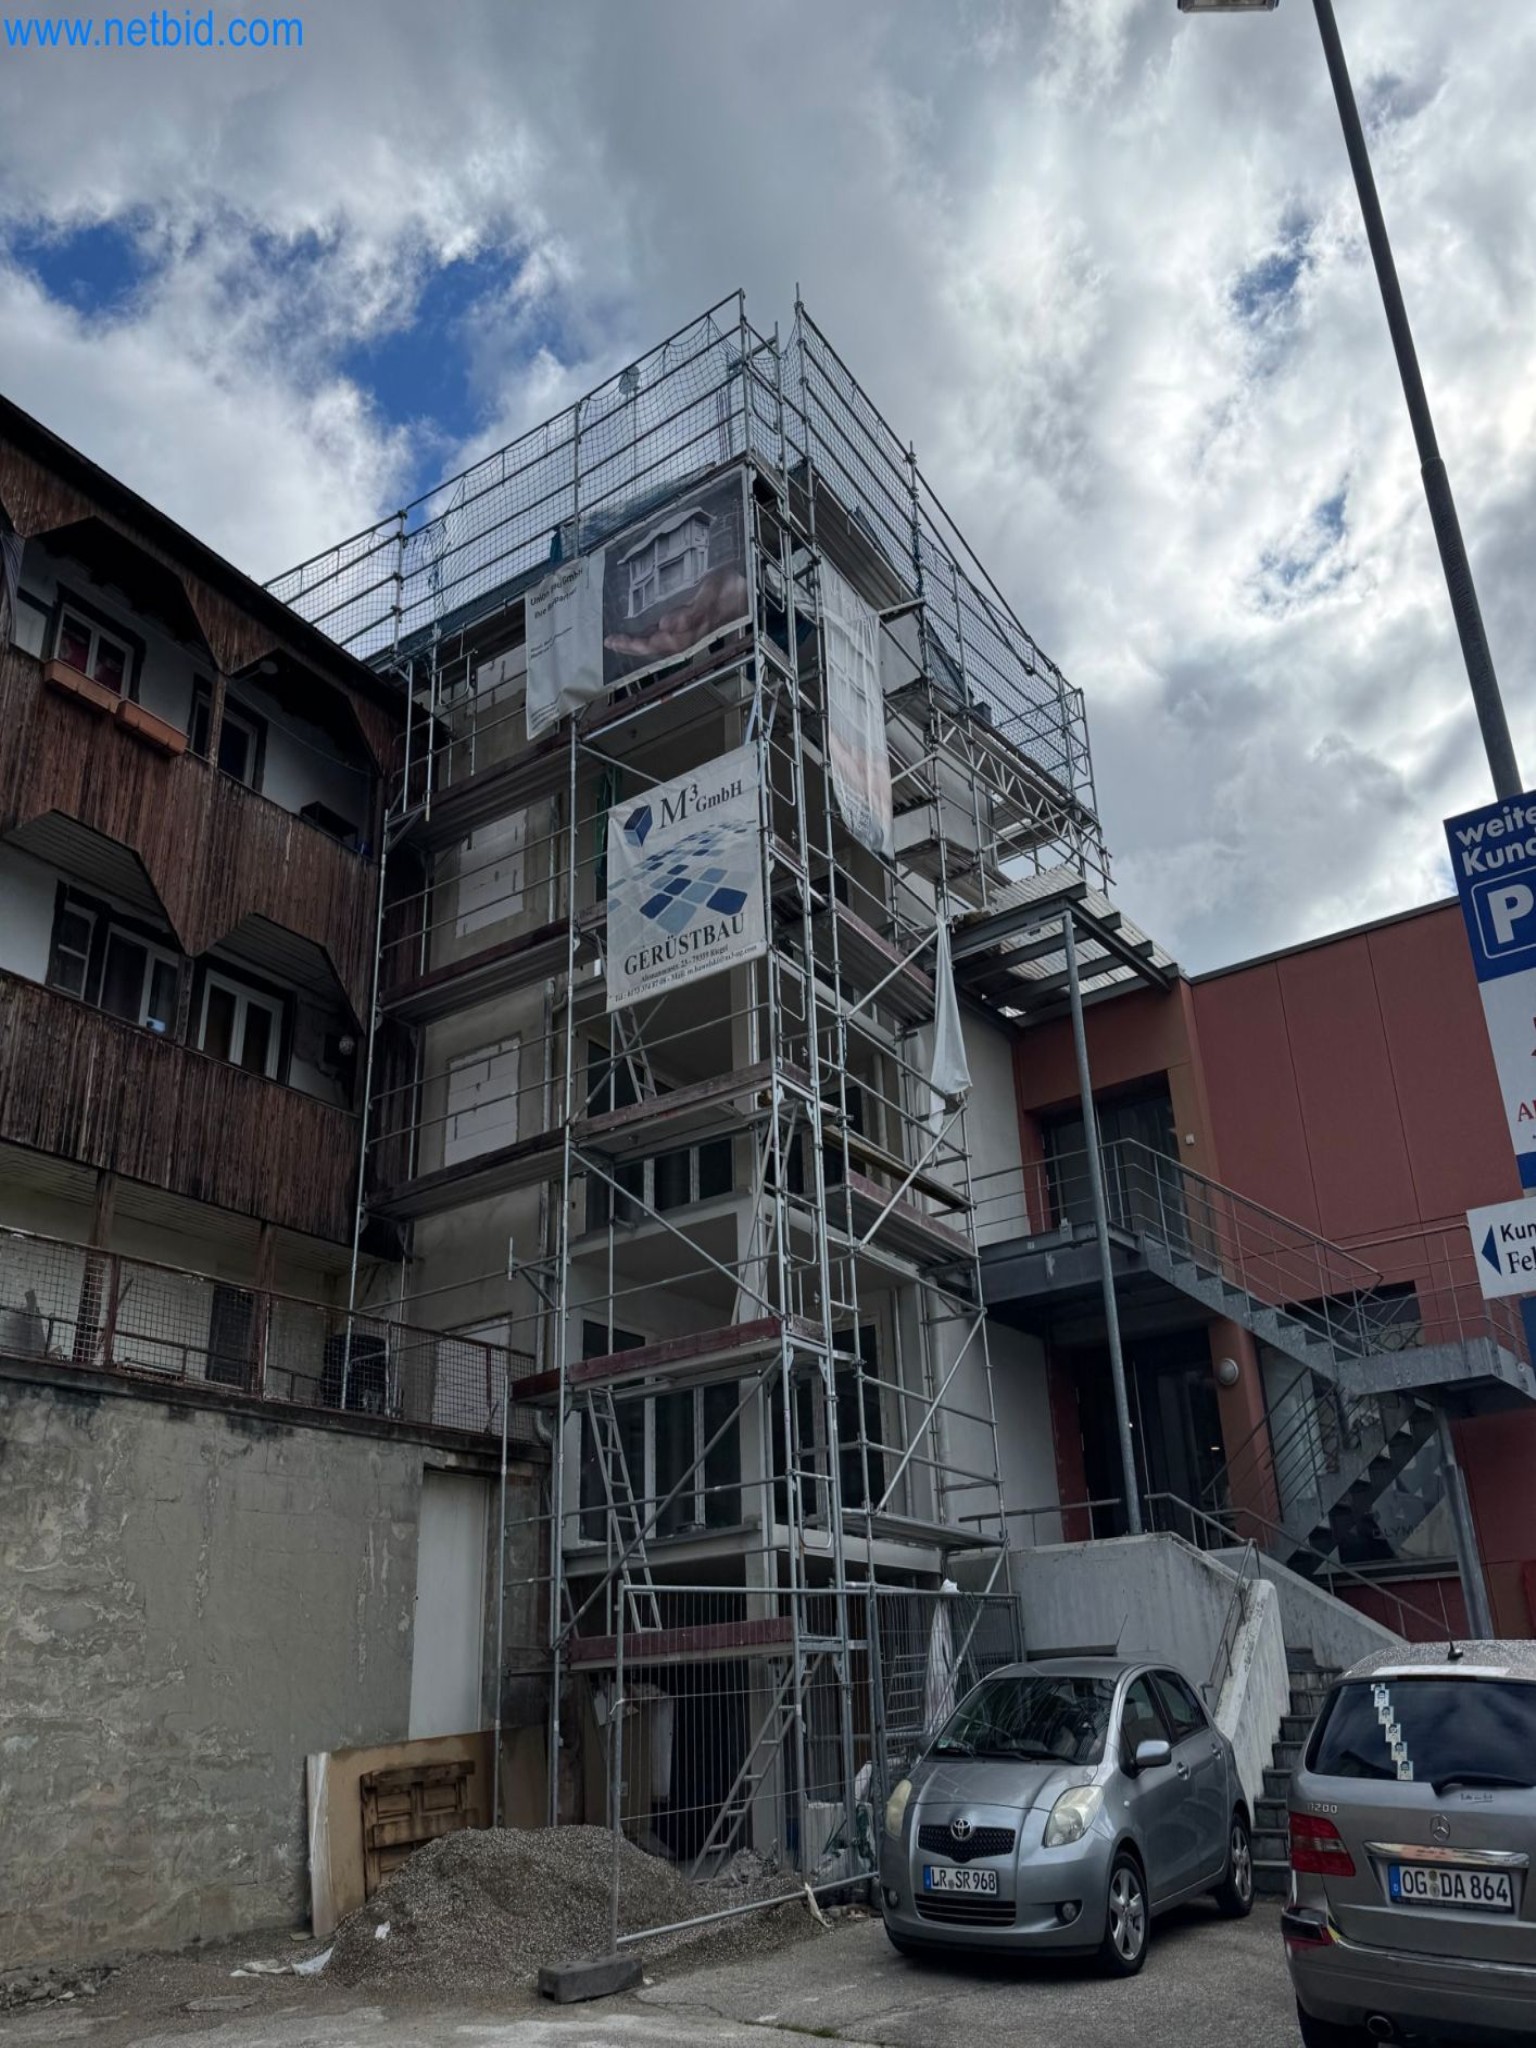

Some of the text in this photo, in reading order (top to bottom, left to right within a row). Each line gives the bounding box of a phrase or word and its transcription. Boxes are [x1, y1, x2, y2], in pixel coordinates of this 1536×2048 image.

[696, 779, 742, 812] GmbH
[1487, 884, 1535, 944] P
[624, 913, 745, 976] GERÜSTBAU
[931, 1868, 996, 1891] LR SR 968
[1402, 1871, 1427, 1895] OG
[1440, 1872, 1466, 1899] DA
[1470, 1876, 1508, 1902] 864
